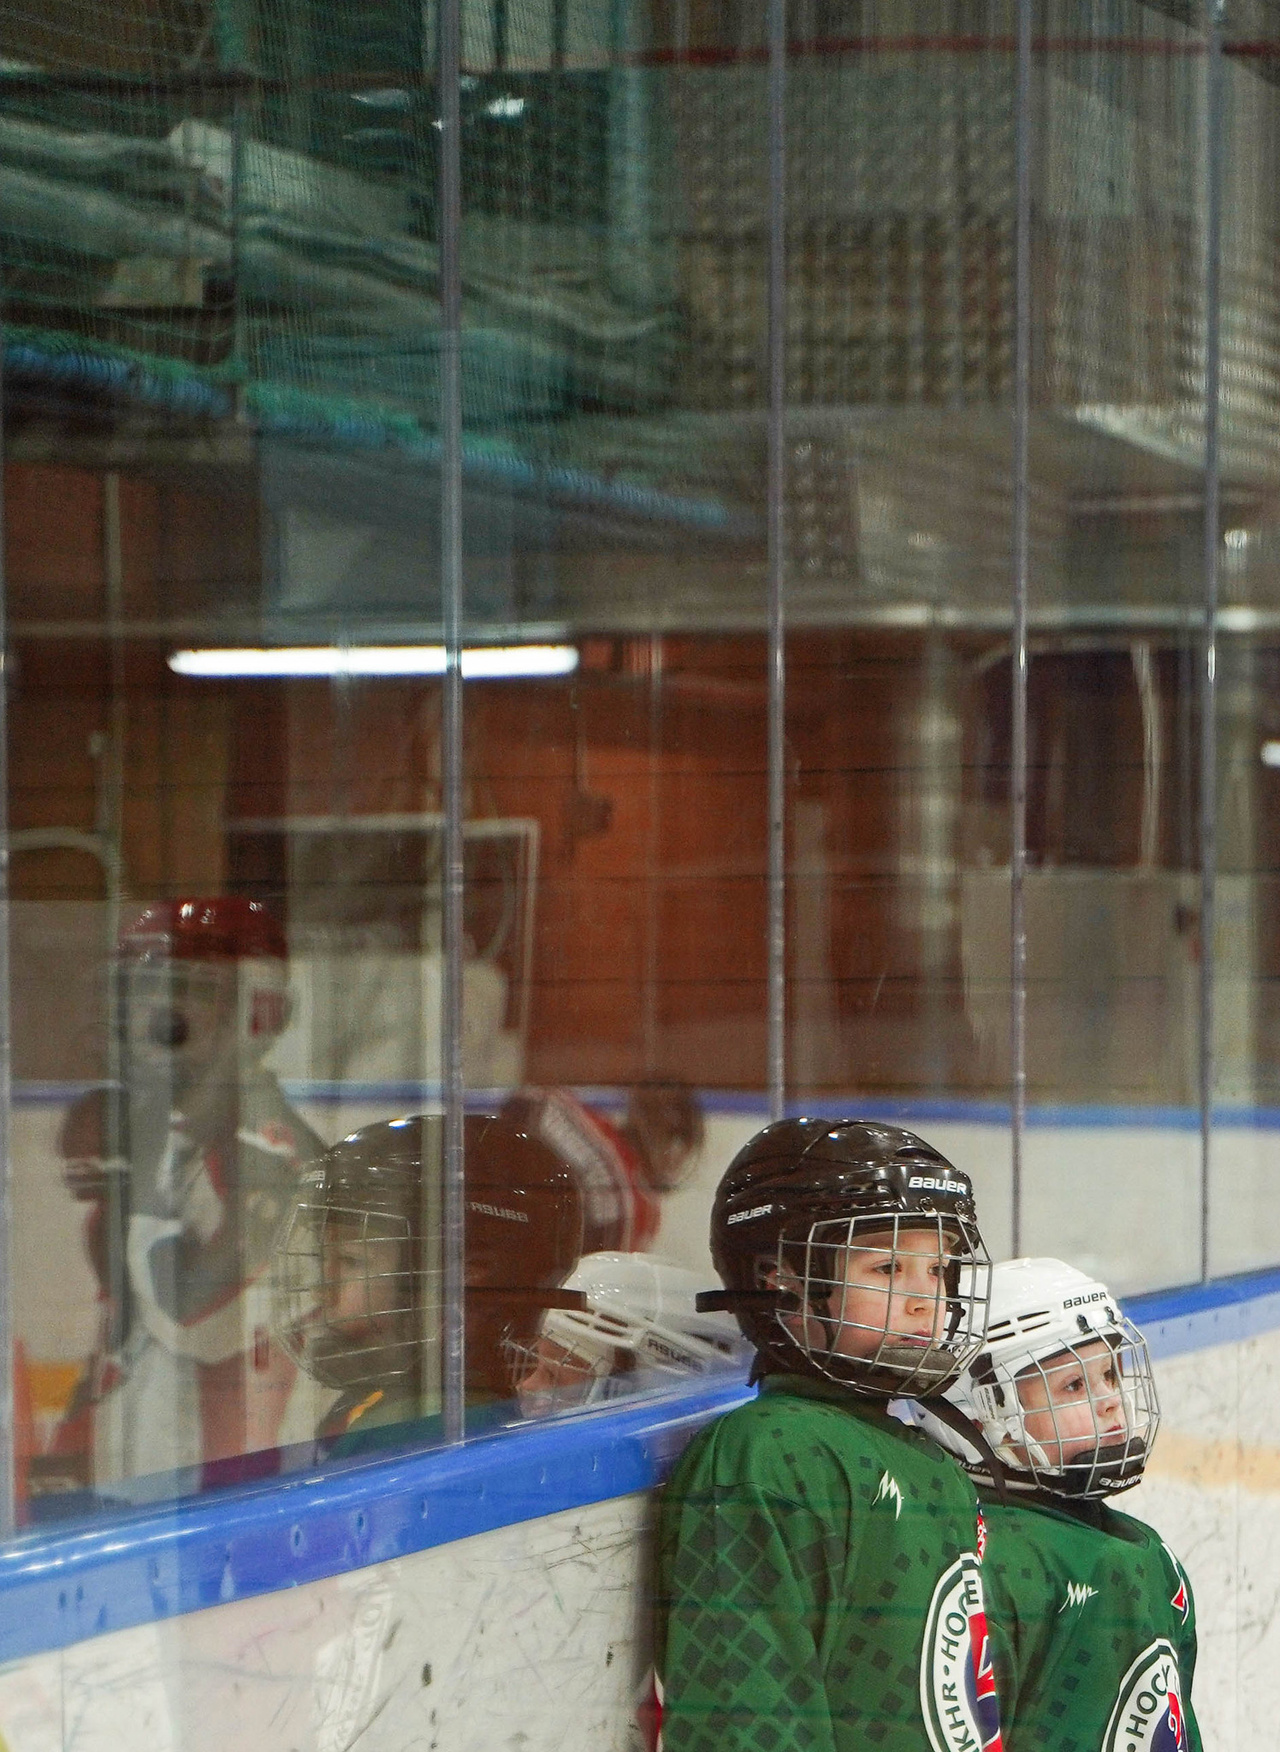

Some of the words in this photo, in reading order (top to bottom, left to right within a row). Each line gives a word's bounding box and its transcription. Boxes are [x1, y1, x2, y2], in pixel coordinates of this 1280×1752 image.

[908, 1176, 967, 1195] BAUER
[727, 1204, 772, 1225] BAUER
[1063, 1291, 1107, 1310] BAUER
[1099, 1474, 1143, 1489] BAUER
